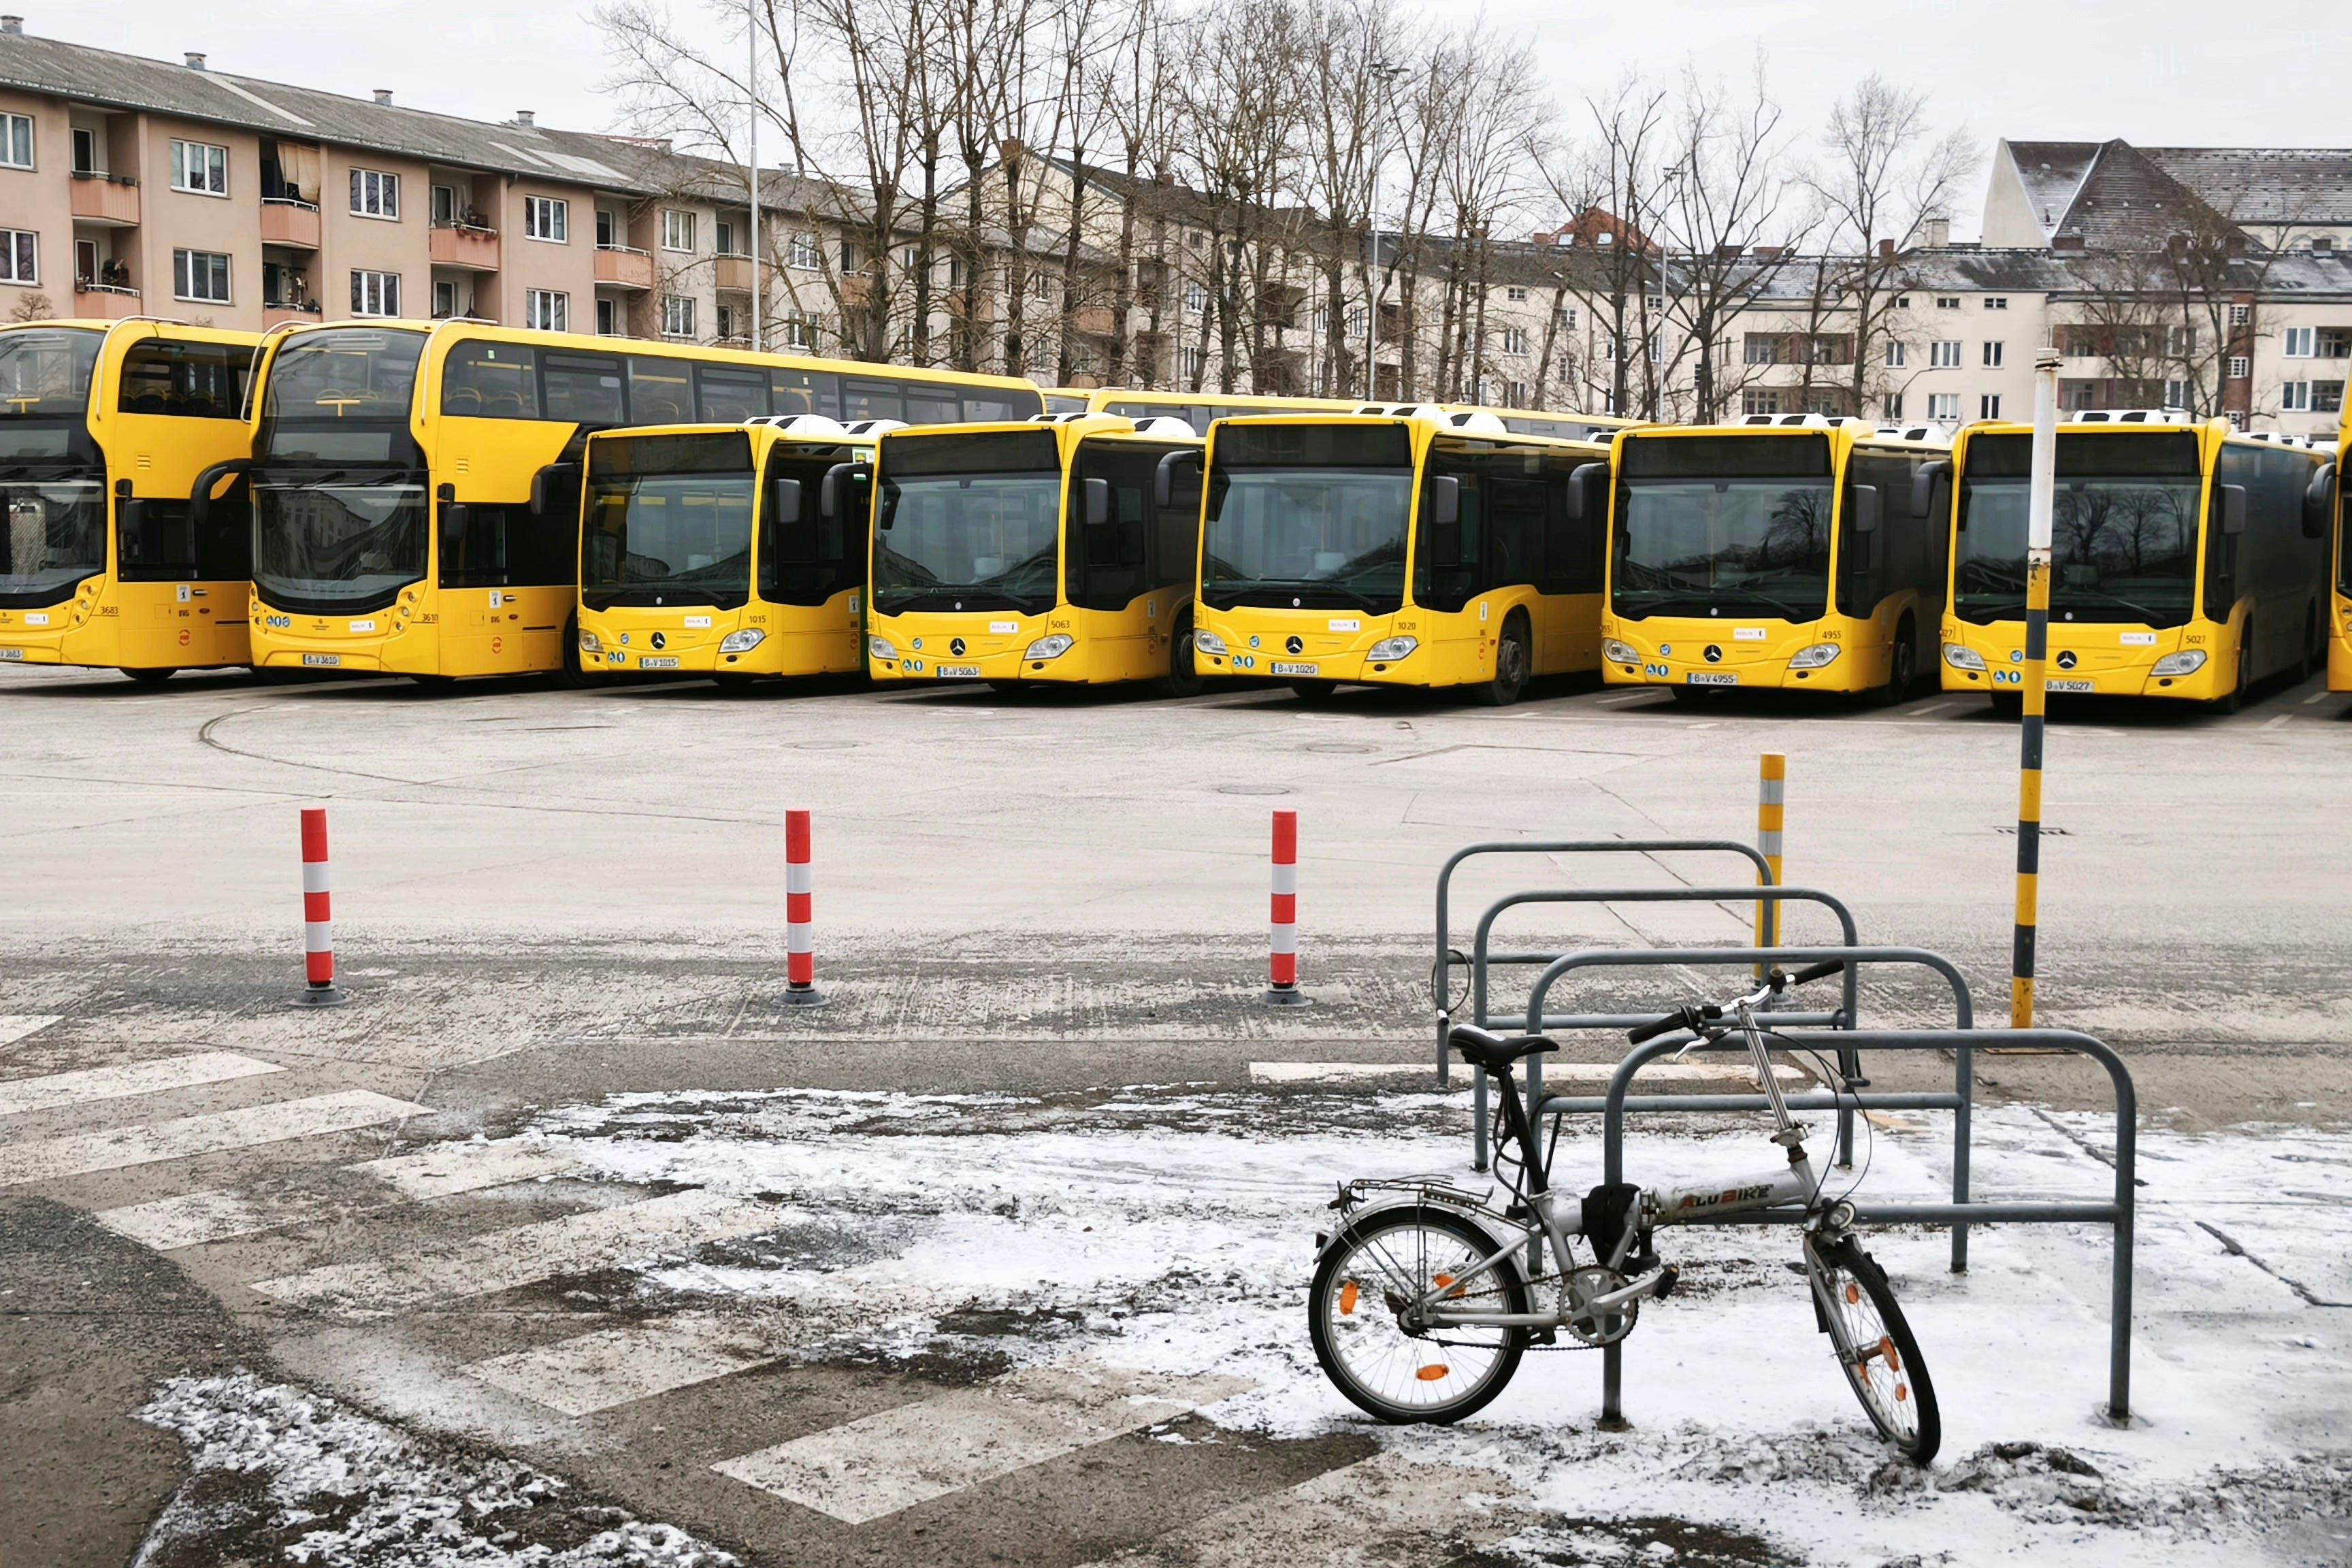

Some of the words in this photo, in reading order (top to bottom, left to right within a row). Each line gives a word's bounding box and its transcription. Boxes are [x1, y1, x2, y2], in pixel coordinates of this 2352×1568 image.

[101, 606, 118, 615] 3683
[423, 613, 438, 621] 3610
[749, 615, 766, 623] 1015
[1051, 621, 1070, 629] 5063
[1397, 622, 1416, 630] 1020
[1822, 630, 1841, 639] 4955
[2186, 635, 2206, 644] 5027
[659, 659, 676, 667] 1015
[959, 668, 977, 676] 5063
[1295, 665, 1315, 674] 1020
[1713, 675, 1734, 683] 4955
[2067, 681, 2089, 690] 5027
